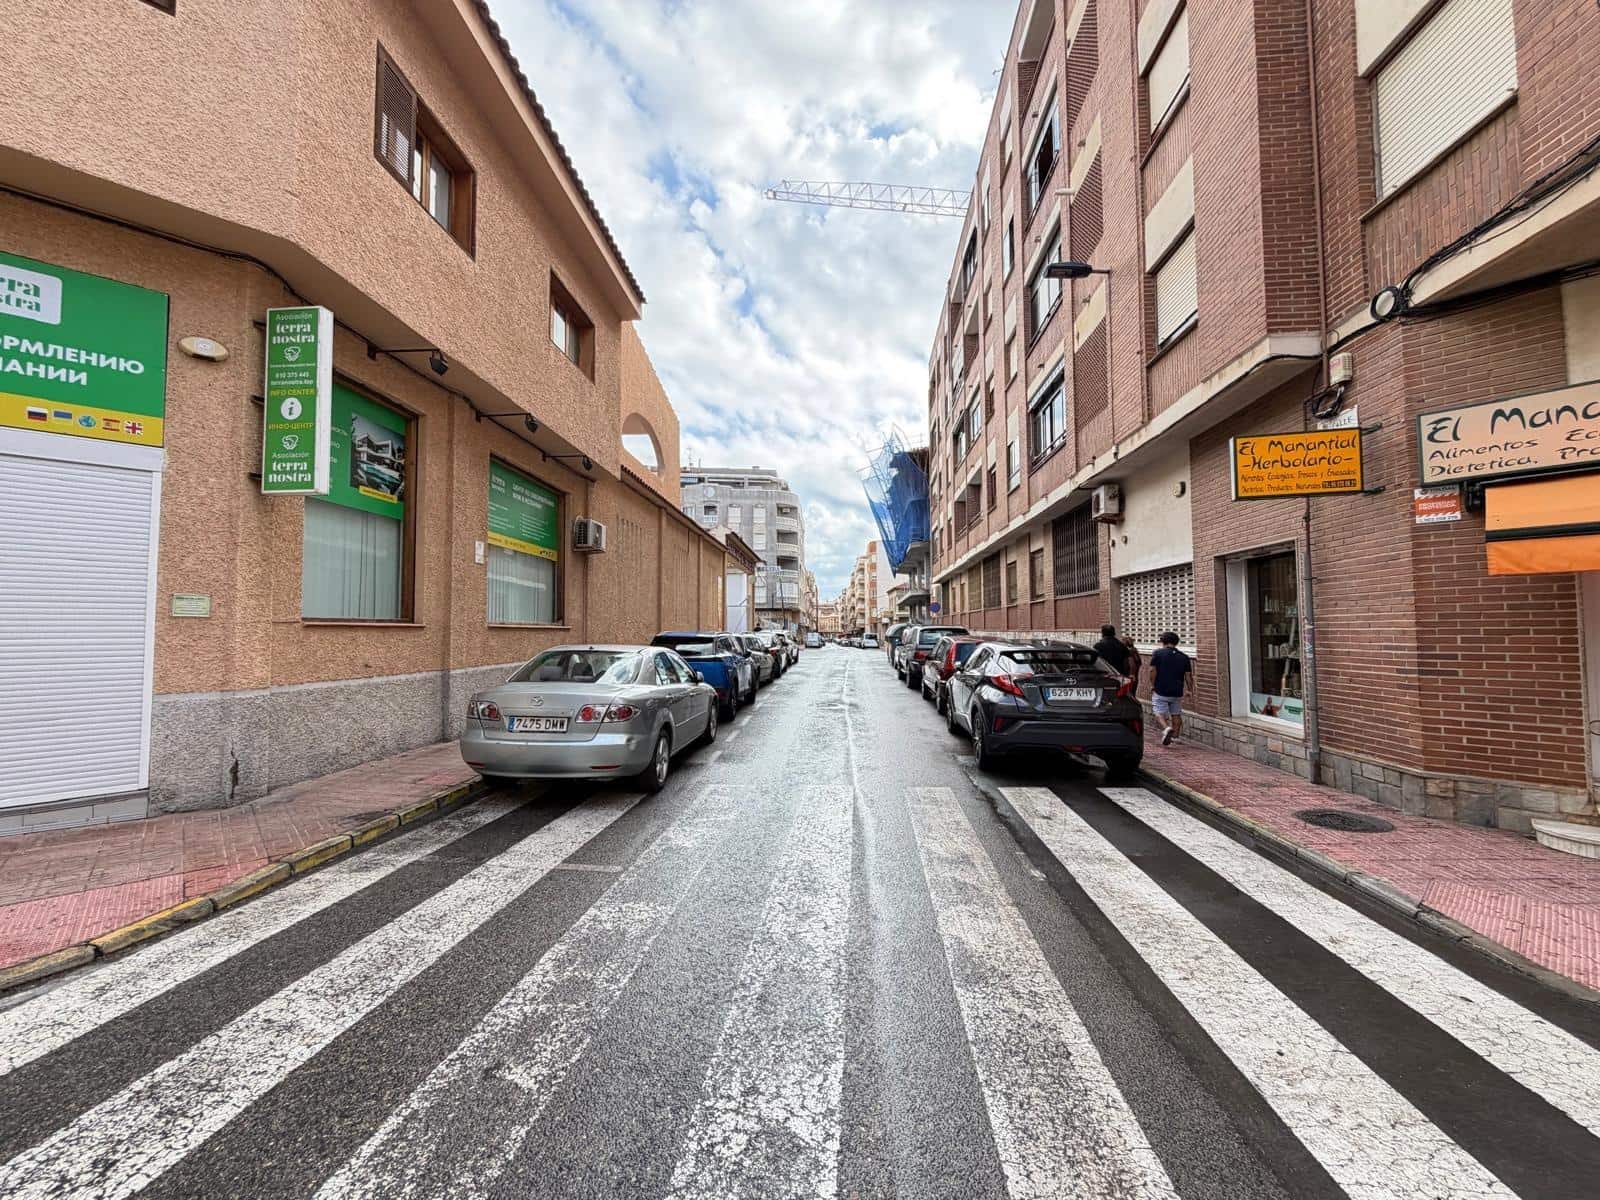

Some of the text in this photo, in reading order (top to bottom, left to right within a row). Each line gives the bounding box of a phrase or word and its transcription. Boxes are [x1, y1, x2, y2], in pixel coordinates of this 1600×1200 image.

[276, 323, 311, 333] terra
[272, 334, 315, 344] nostra
[0, 335, 145, 374] РМЛЕНИЮ
[0, 356, 88, 386] АНИИ
[1426, 415, 1462, 444] El
[1239, 434, 1356, 456] El Manantial
[1429, 428, 1600, 461] Alimentos Ec
[272, 461, 308, 471] terra
[268, 473, 311, 483] nostra
[1051, 688, 1094, 697] 6297 KHY
[515, 718, 542, 729] 7475
